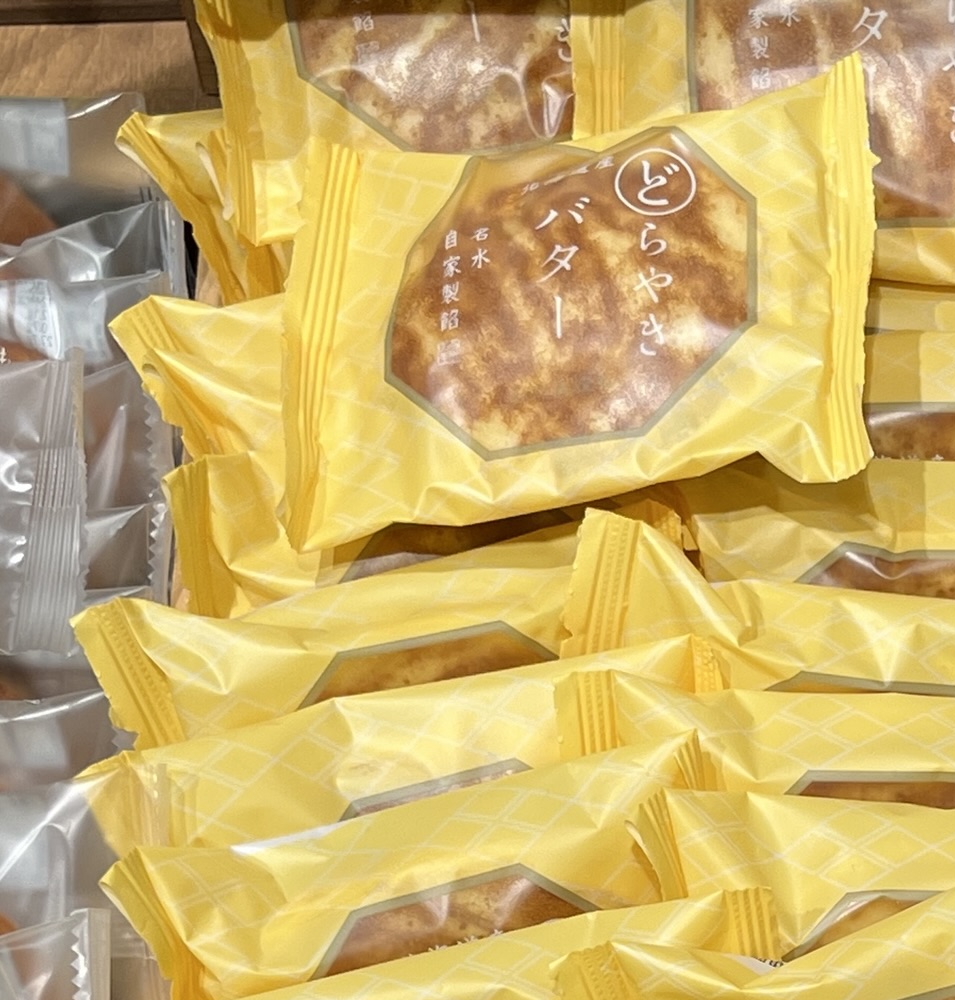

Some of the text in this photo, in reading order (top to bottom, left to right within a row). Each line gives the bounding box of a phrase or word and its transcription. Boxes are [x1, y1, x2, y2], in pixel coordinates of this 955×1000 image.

[470, 226, 491, 270] 名水
[535, 196, 591, 340] バター
[633, 160, 681, 356] どらやき
